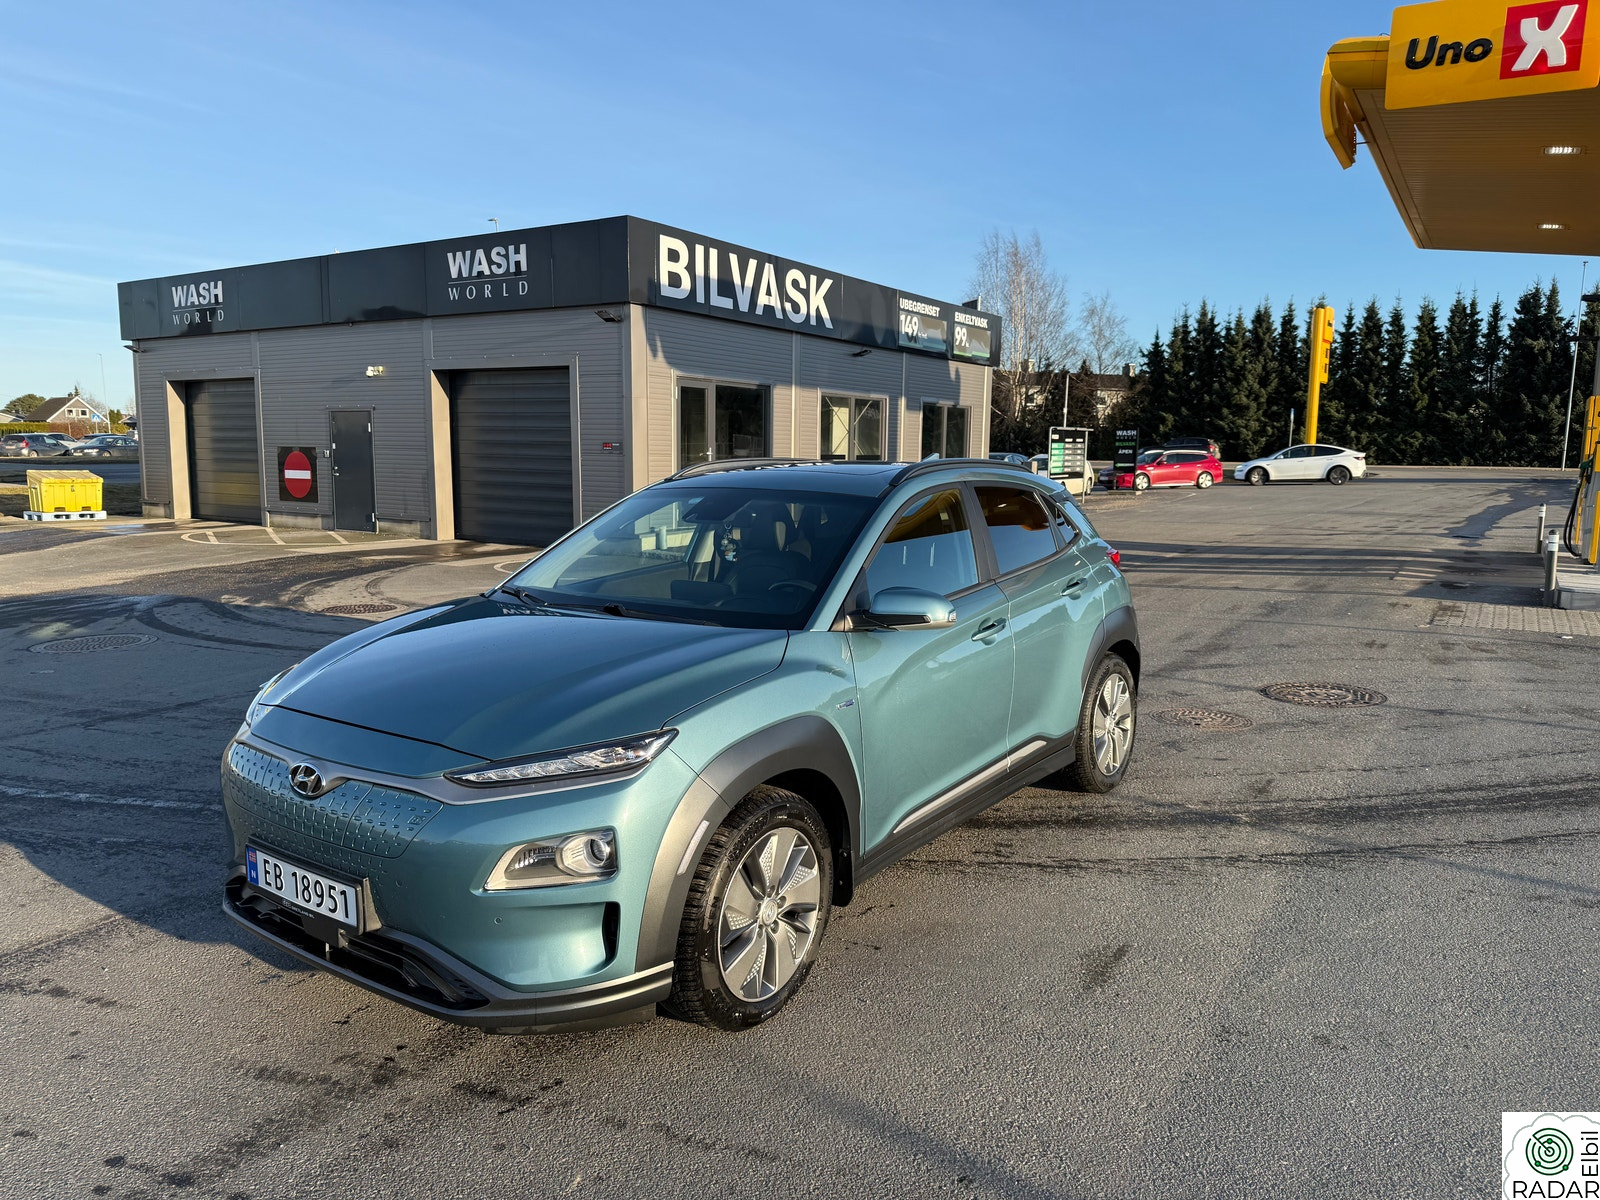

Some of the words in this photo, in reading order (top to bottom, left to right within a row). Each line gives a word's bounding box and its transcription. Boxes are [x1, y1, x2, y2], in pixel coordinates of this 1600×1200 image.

[1405, 35, 1493, 70] Uno
[447, 244, 528, 278] WASH
[448, 281, 529, 300] WORLD
[659, 234, 834, 329] BILVASK
[171, 280, 223, 307] WASH
[172, 310, 224, 325] WORLD
[899, 297, 941, 317] UBEGRENSET
[900, 314, 919, 337] 149
[954, 311, 989, 329] ENKELTVASK
[955, 326, 967, 346] 99
[251, 869, 257, 879] N
[263, 858, 284, 892] EB
[291, 871, 350, 919] 18951
